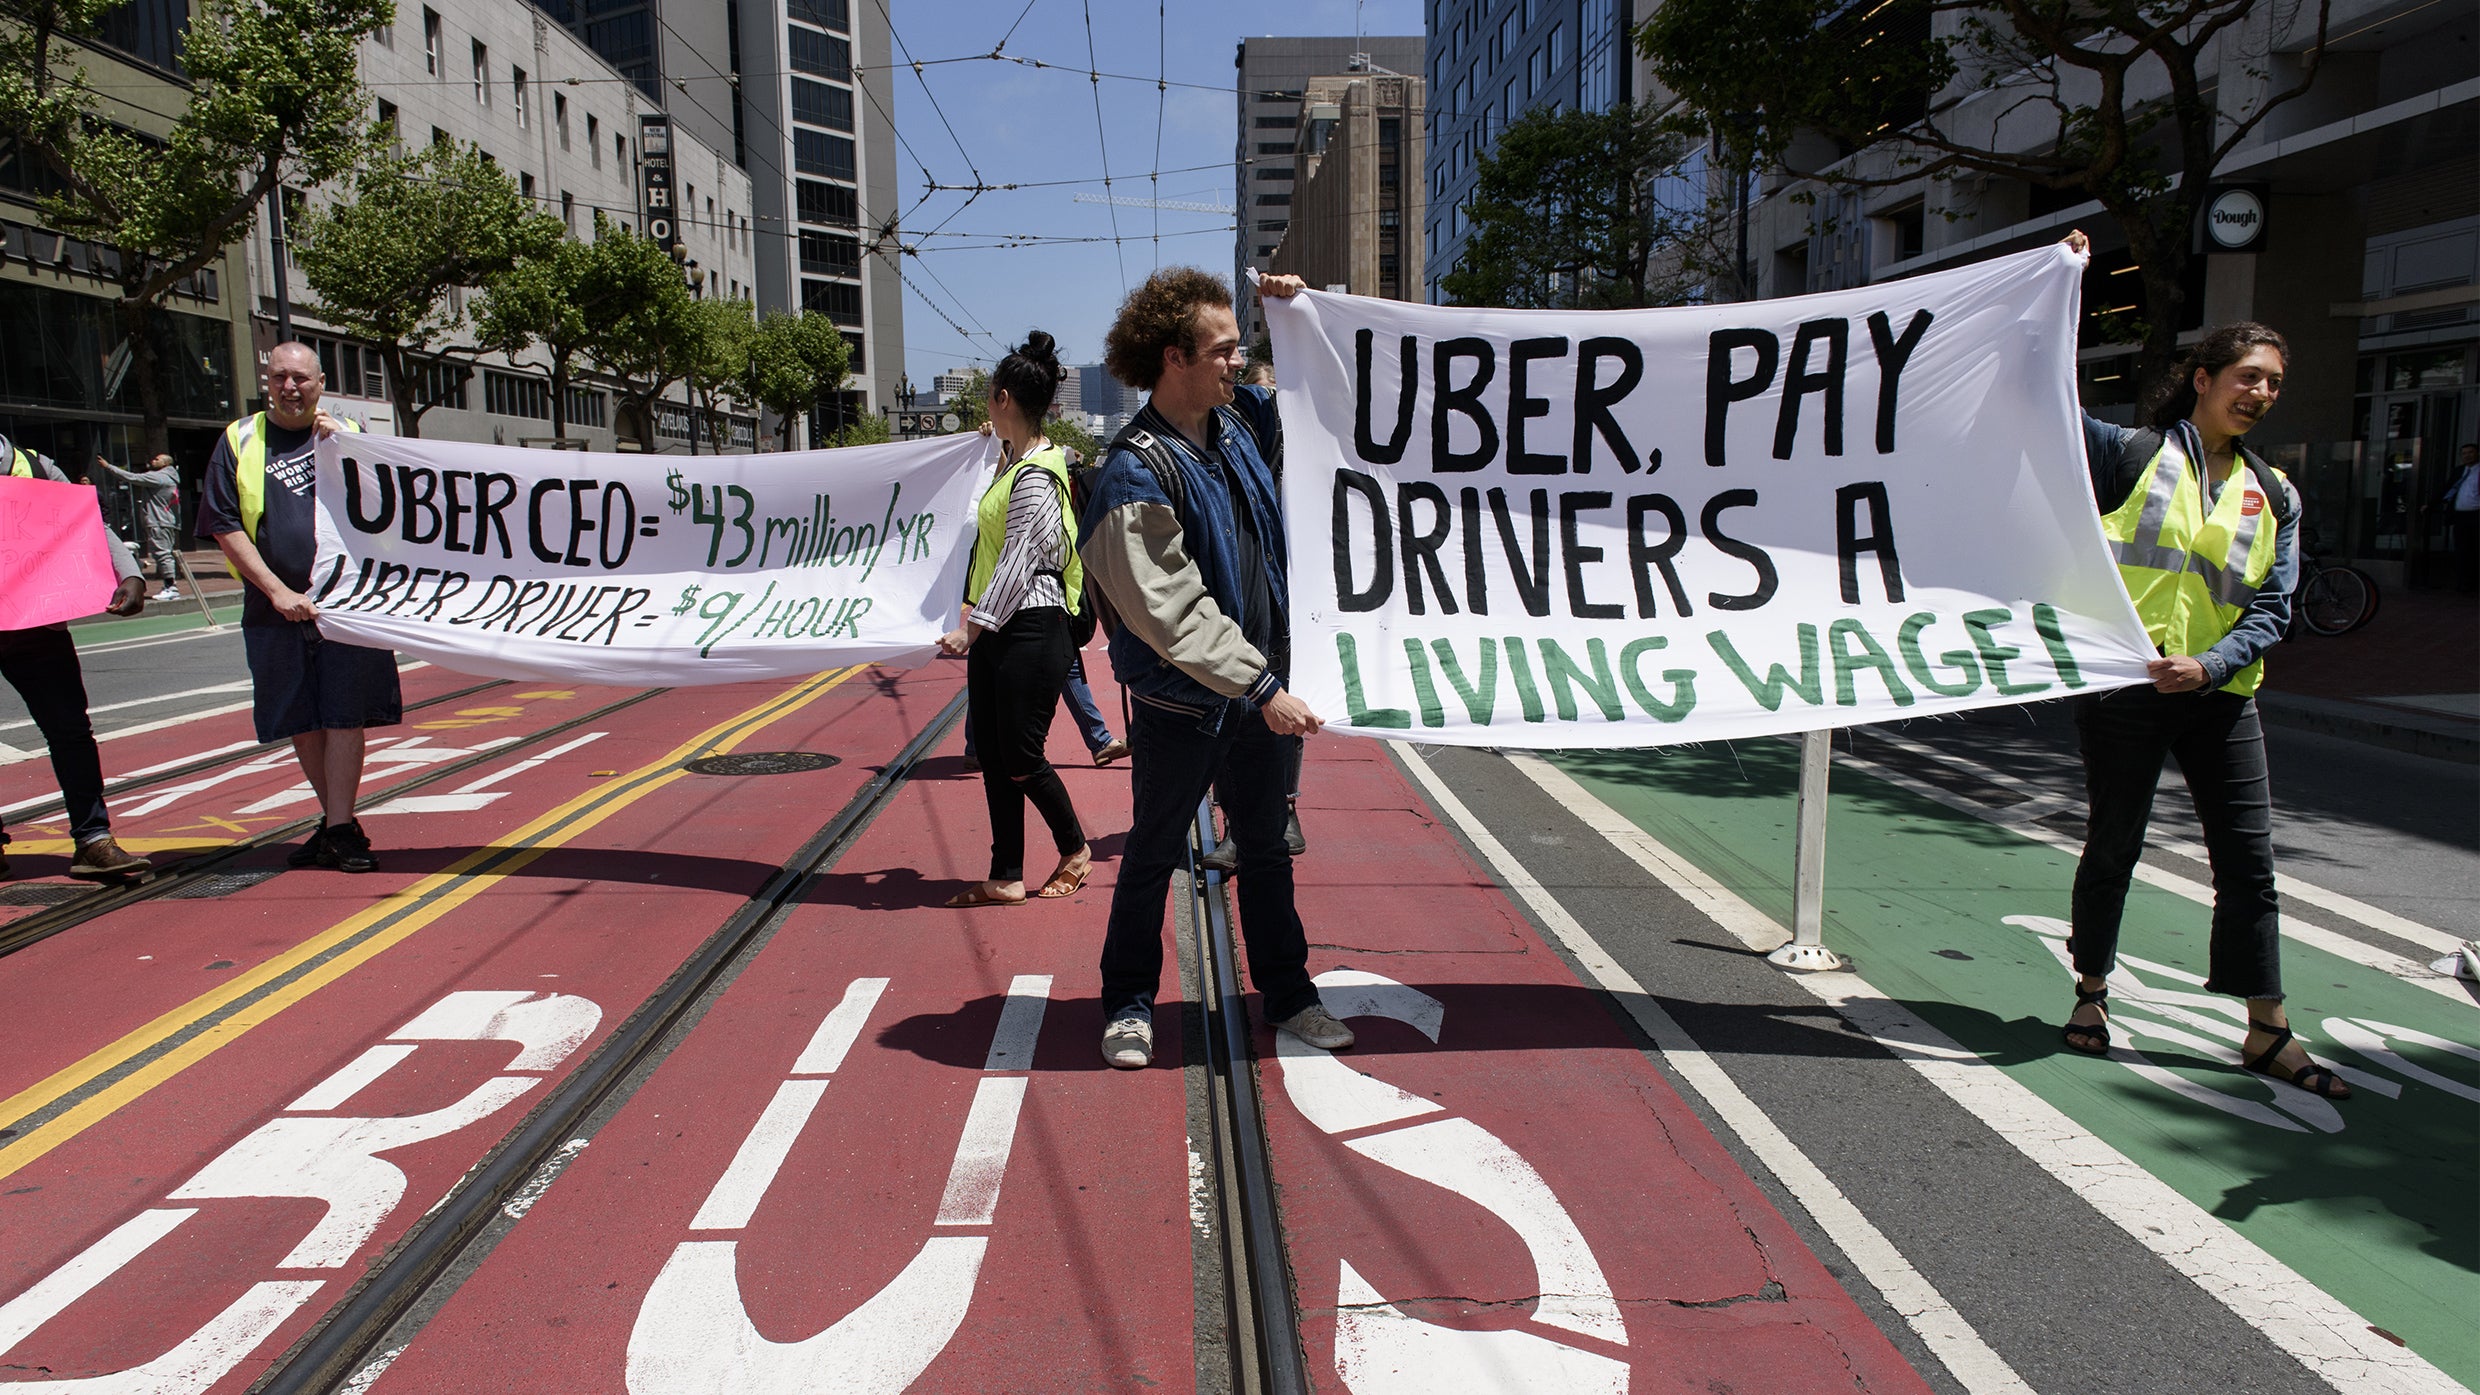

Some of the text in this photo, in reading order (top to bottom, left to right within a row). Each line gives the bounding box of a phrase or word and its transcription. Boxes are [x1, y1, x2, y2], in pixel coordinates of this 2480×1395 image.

[644, 158, 669, 168] HOTEL
[652, 173, 663, 182] &
[648, 187, 672, 258] HO
[2213, 209, 2257, 228] Dough
[1354, 308, 1935, 475] UBER, PAY
[265, 459, 287, 474] GIG
[342, 457, 513, 559] UBER
[667, 468, 754, 567] $43
[1332, 467, 1906, 619] DRIVERS A
[315, 554, 470, 622] UBER
[1336, 630, 1698, 729] LIVING
[0, 972, 1632, 1395] BUS
